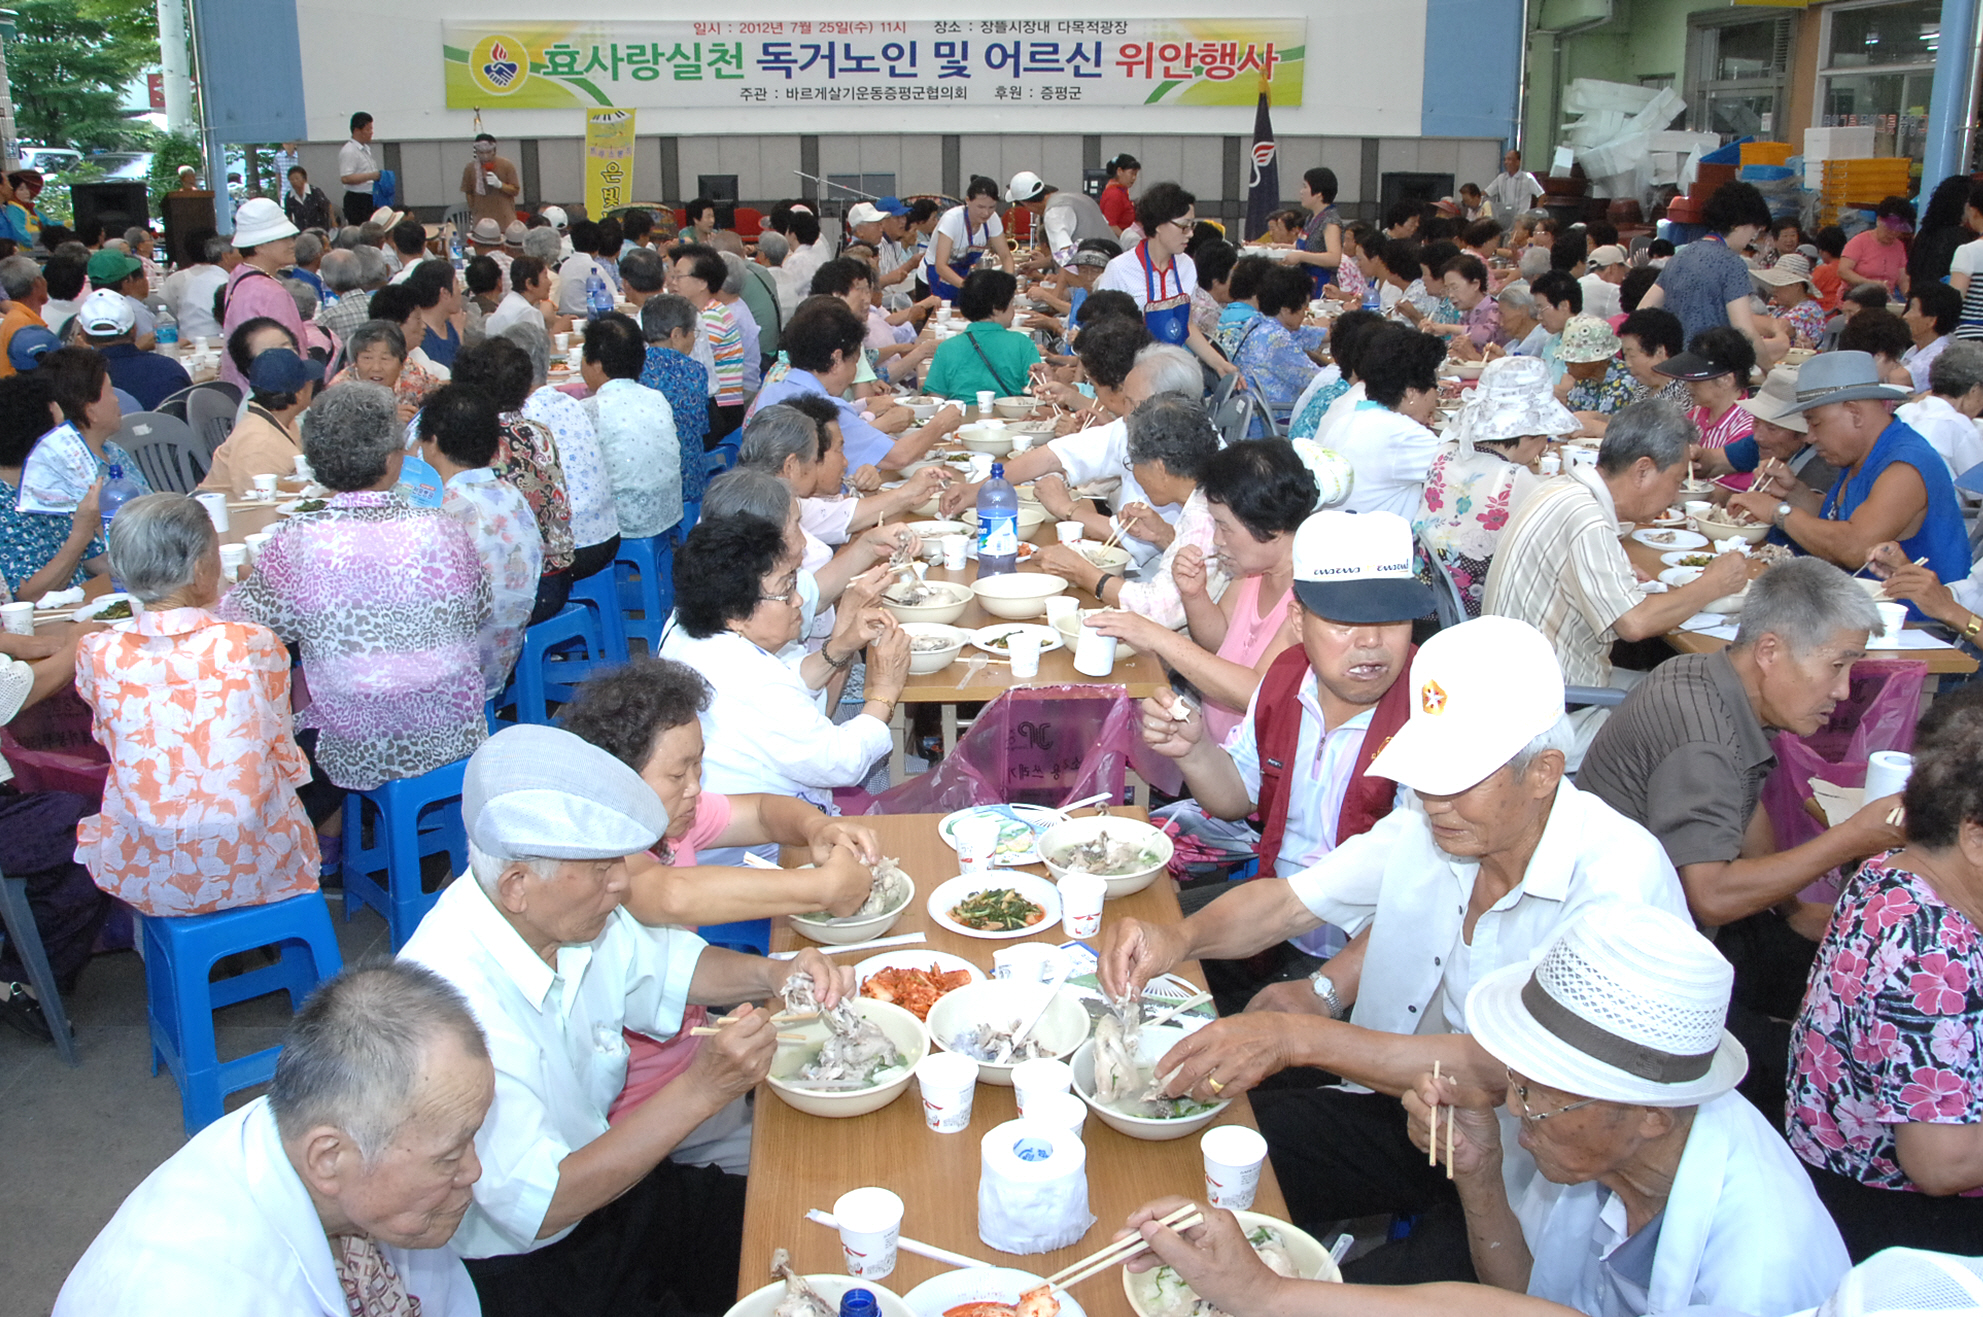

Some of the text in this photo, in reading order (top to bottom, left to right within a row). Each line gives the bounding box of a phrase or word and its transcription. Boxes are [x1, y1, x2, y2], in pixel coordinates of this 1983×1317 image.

[694, 22, 720, 35] 일시
[739, 22, 784, 35] 2012년
[791, 22, 812, 35] 7월
[819, 21, 874, 34] 25일(수)
[881, 21, 906, 34] 11시
[933, 20, 962, 34] 장소
[1058, 19, 1129, 35] 다목적광장
[541, 40, 1279, 82] 효사랑실천 독거노인 및 어르신 위안행사
[740, 86, 767, 102] 주관
[786, 85, 968, 102] 바르게살기운동증평군협의회
[994, 85, 1022, 101] 후원
[1040, 85, 1083, 101] 증평군
